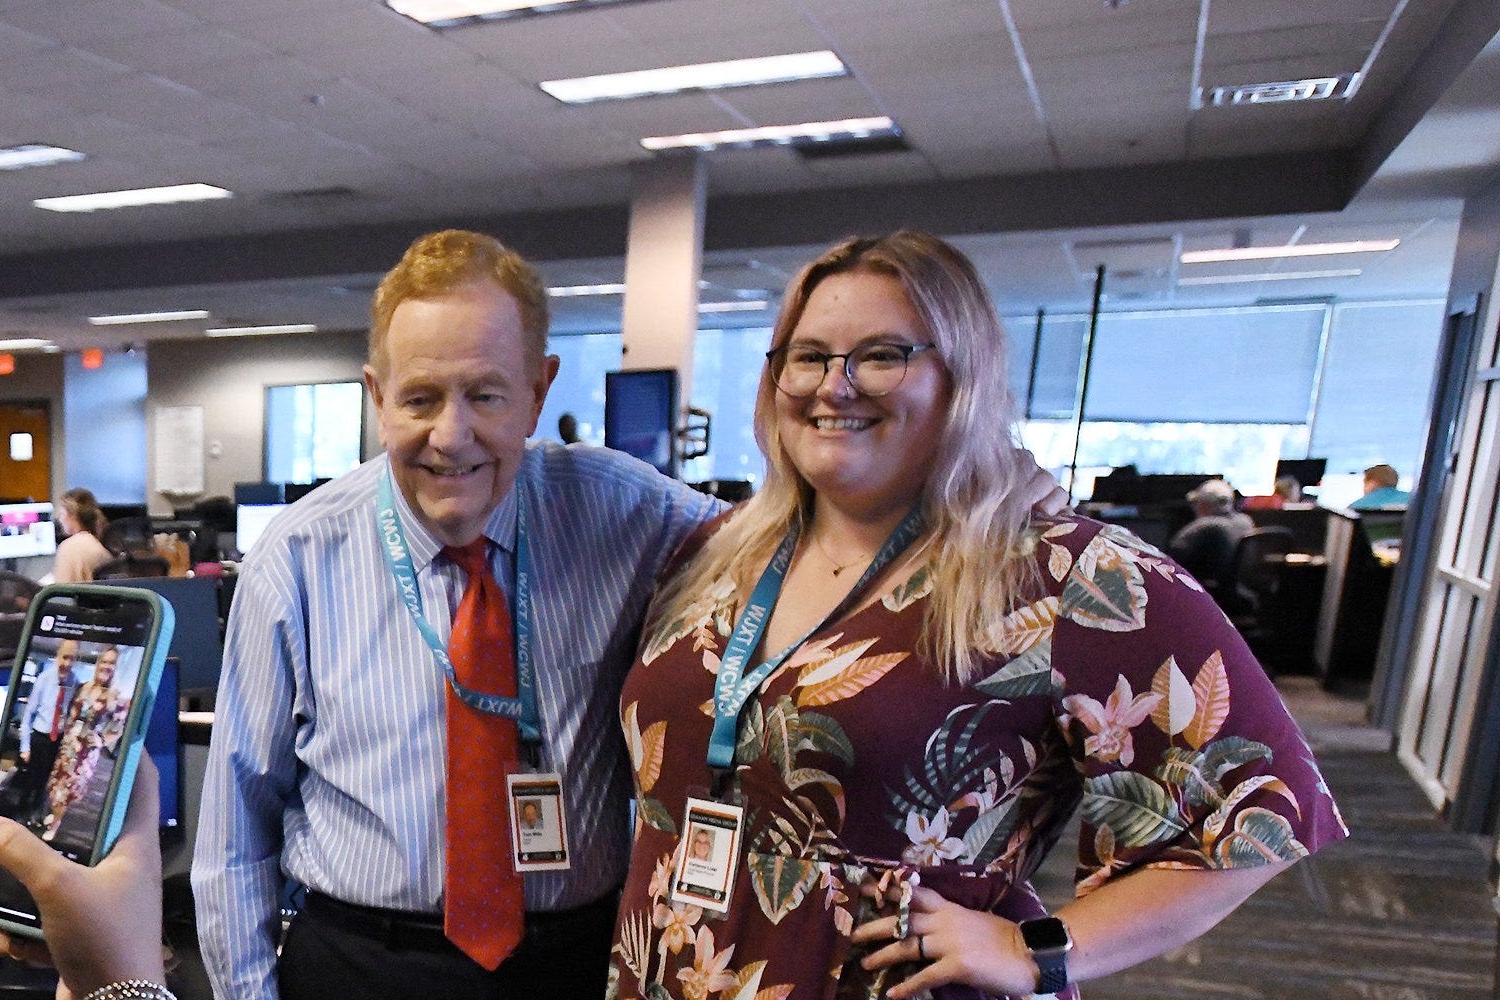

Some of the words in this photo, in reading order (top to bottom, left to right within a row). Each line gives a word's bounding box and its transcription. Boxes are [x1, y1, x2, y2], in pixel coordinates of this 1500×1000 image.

[379, 508, 406, 561] WCWJ
[397, 574, 421, 618] WJXT
[735, 604, 766, 646] WJXT
[717, 655, 744, 713] WCWJ
[724, 670, 764, 717] WJXT
[475, 698, 523, 718] WJXT
